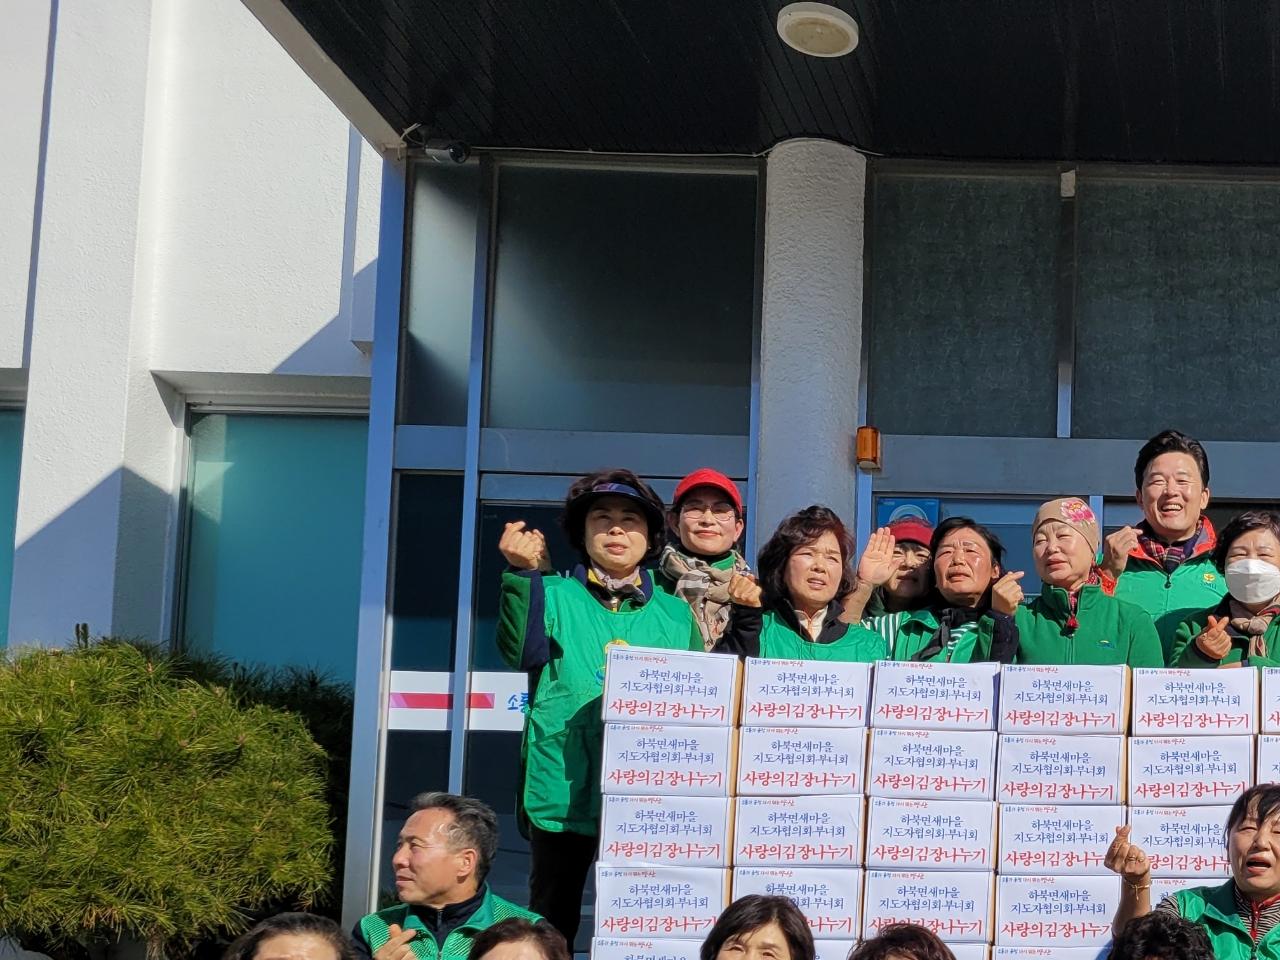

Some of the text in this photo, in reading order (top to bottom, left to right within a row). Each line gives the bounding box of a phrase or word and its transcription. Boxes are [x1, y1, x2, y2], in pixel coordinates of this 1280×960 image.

[639, 668, 703, 684] 하북면새마을
[776, 672, 840, 685] 하북면새마을
[905, 674, 967, 689] 하북면새마을
[1031, 679, 1094, 693] 하북면새마을
[1164, 681, 1226, 694] 하북면새마을
[609, 698, 725, 721] 사랑의김장나누기
[748, 701, 862, 721] 사랑의김장나누기
[877, 703, 988, 724] 사랑의김장나누기
[1004, 709, 1115, 729] 사랑의김장나누기
[1138, 711, 1249, 729] 사랑의김장나누기
[636, 737, 700, 751] 하북면새마을
[771, 740, 834, 753] 하북면새마을
[901, 742, 964, 757] 하북면새마을
[1029, 750, 1092, 764] 하북면새마을
[1159, 750, 1222, 763] 하북면새마을
[607, 768, 722, 788] 사랑의김장나누기
[742, 770, 856, 789] 사랑의김장나누기
[873, 772, 986, 794] 사랑의김장나누기
[1001, 781, 1113, 800] 사랑의김장나누기
[1133, 781, 1245, 798] 사랑의김장나누기
[634, 809, 698, 823] 하북면새마을
[767, 812, 831, 825] 하북면새마을
[900, 813, 964, 828] 하북면새마을
[1032, 819, 1095, 832] 하북면새마을
[605, 841, 720, 860] 사랑의김장나누기
[739, 843, 853, 861] 사랑의김장나누기
[872, 844, 986, 864] 사랑의김장나누기
[1004, 850, 1106, 867] 사랑의김장나누
[1147, 853, 1234, 871] 랑의김장나누
[629, 883, 694, 896] 하북면새마을
[897, 885, 961, 899] 하북면새마을
[1028, 889, 1092, 903] 하북면새마을
